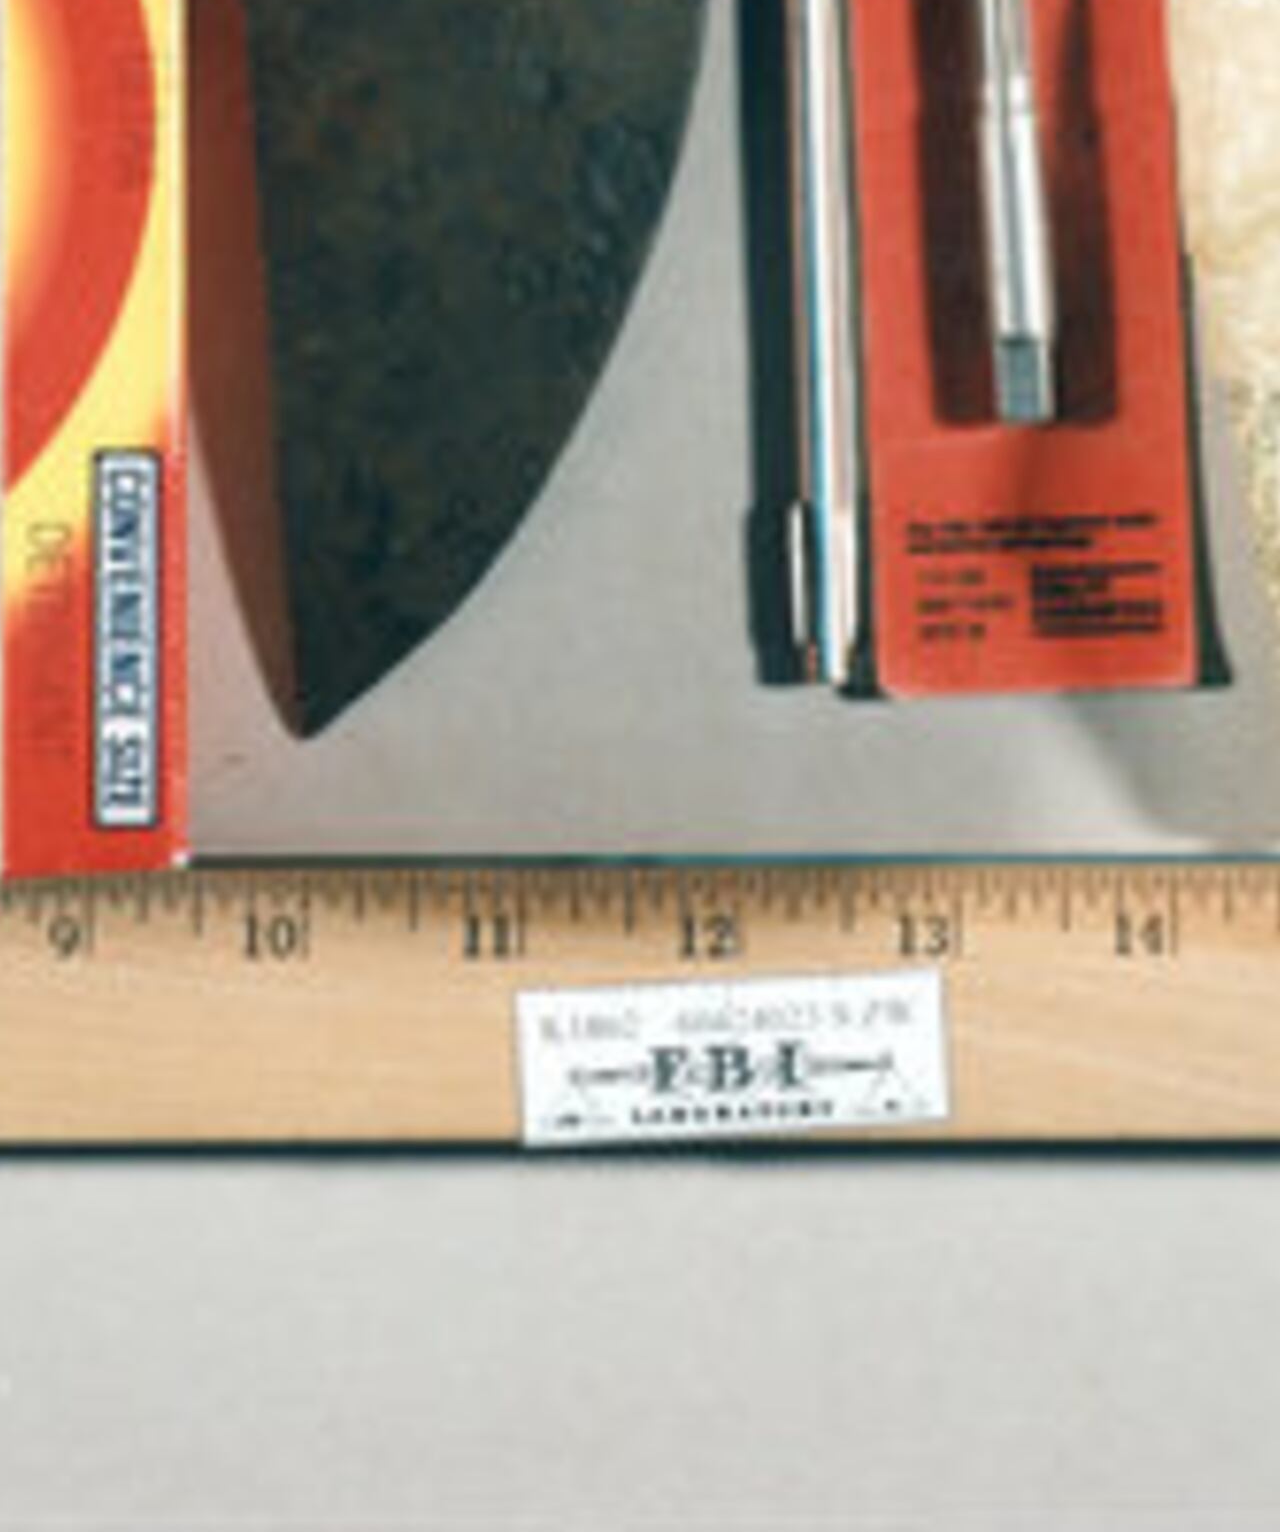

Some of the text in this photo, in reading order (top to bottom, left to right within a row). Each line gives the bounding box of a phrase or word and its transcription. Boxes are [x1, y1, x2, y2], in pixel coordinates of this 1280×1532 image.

[108, 469, 143, 807] CONVENIENCE SIZE
[47, 915, 81, 957] 9
[242, 914, 298, 959] 10
[462, 914, 513, 958] 11
[680, 914, 737, 958] 12
[898, 913, 950, 957] 13
[1116, 913, 1164, 956] 14
[648, 1037, 806, 1095] FBI
[630, 1099, 836, 1126] LABORATORY
